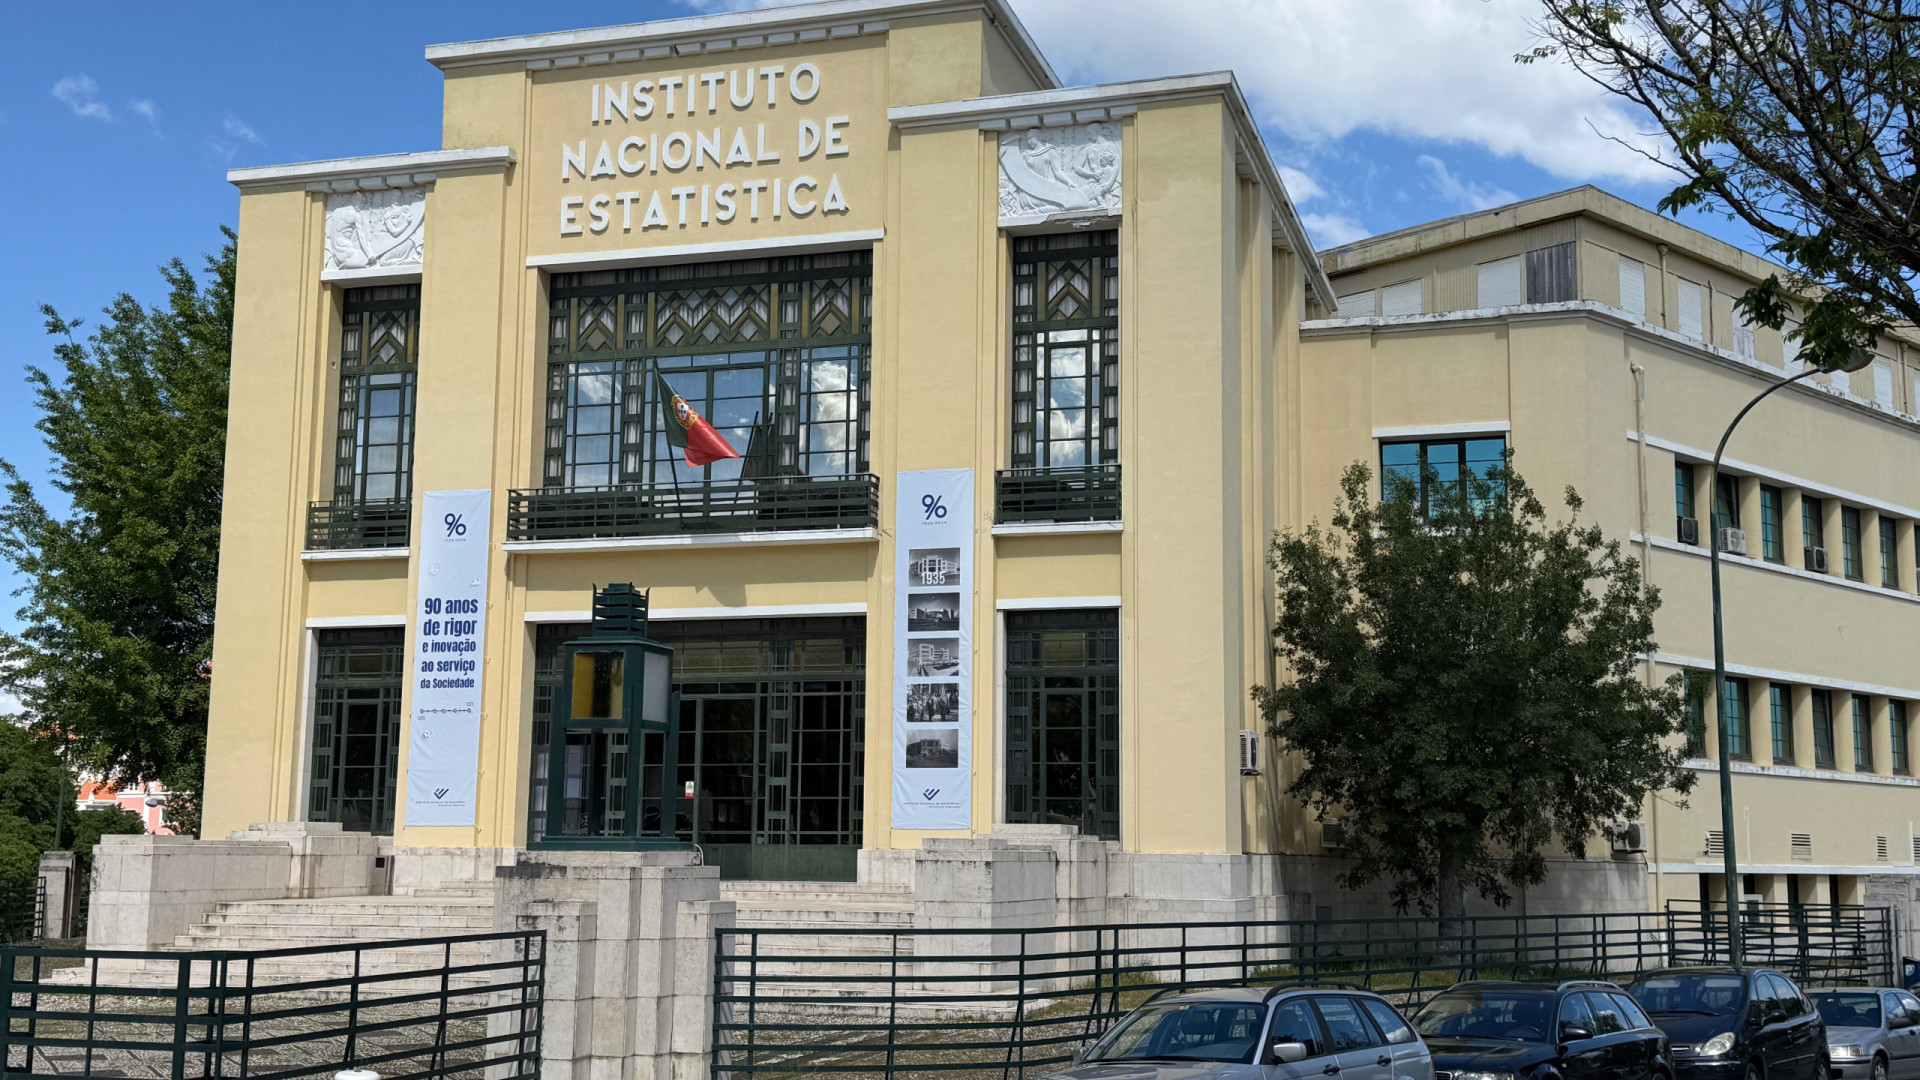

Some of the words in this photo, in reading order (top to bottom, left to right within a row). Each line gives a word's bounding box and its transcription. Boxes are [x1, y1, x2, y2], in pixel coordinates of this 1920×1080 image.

[591, 62, 821, 123] INSTITUTO
[562, 123, 780, 180] NACIONAL
[798, 115, 850, 157] DE
[560, 173, 848, 234] ESTATISTICA
[921, 571, 946, 585] 1935
[424, 598, 442, 615] 90
[445, 598, 479, 614] anos
[423, 619, 440, 636] de
[444, 617, 478, 638] rigor
[422, 642, 429, 653] e
[431, 639, 477, 656] inovação
[421, 660, 434, 673] ao
[436, 658, 476, 676] serviço
[420, 678, 431, 689] da
[432, 677, 475, 689] Sociedade
